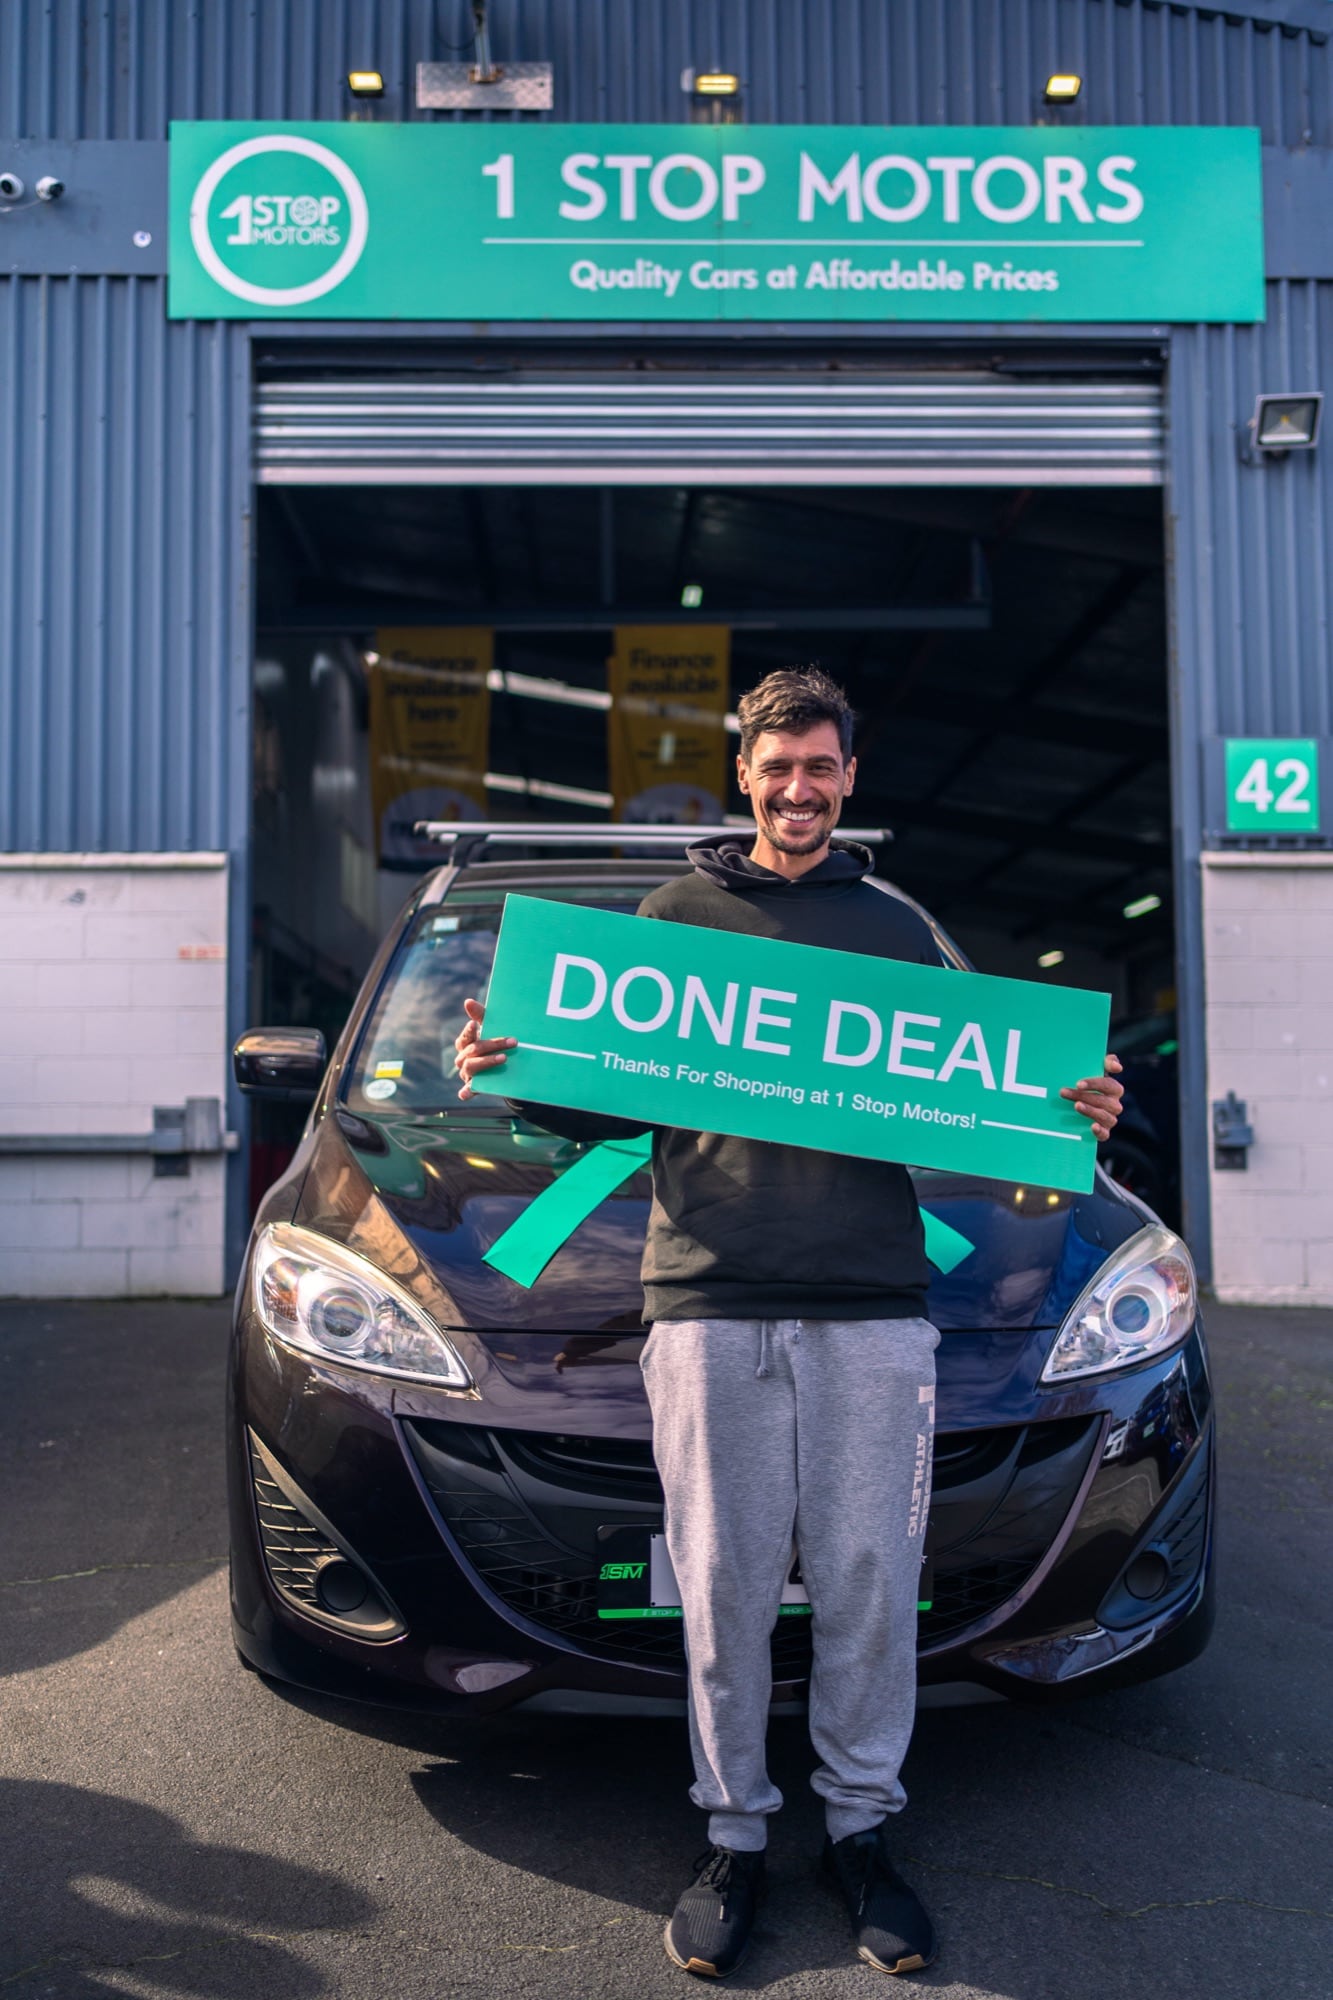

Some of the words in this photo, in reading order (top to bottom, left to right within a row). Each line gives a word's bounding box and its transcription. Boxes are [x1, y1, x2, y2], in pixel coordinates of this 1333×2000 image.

[253, 195, 341, 226] STOP
[482, 154, 514, 218] 1
[559, 153, 766, 222] STOP
[798, 152, 1144, 224] MOTORS
[252, 226, 341, 246] MOTORS
[569, 258, 682, 297] Quality
[689, 260, 759, 291] Cars
[766, 264, 798, 291] at
[804, 258, 966, 291] Affordable
[973, 262, 1059, 291] Prices
[628, 647, 716, 669] Finance
[625, 671, 720, 695] available
[1235, 758, 1310, 813] 42
[545, 952, 798, 1056] DONE
[822, 999, 1048, 1099] DEAL
[602, 1051, 670, 1078] Thanks
[676, 1064, 709, 1084] For
[713, 1070, 805, 1105] Shopping
[810, 1090, 830, 1105] at
[836, 1091, 844, 1107] 1
[851, 1093, 897, 1119] Stop
[902, 1102, 976, 1129] Motors!
[907, 1433, 926, 1538] ATHLETIC
